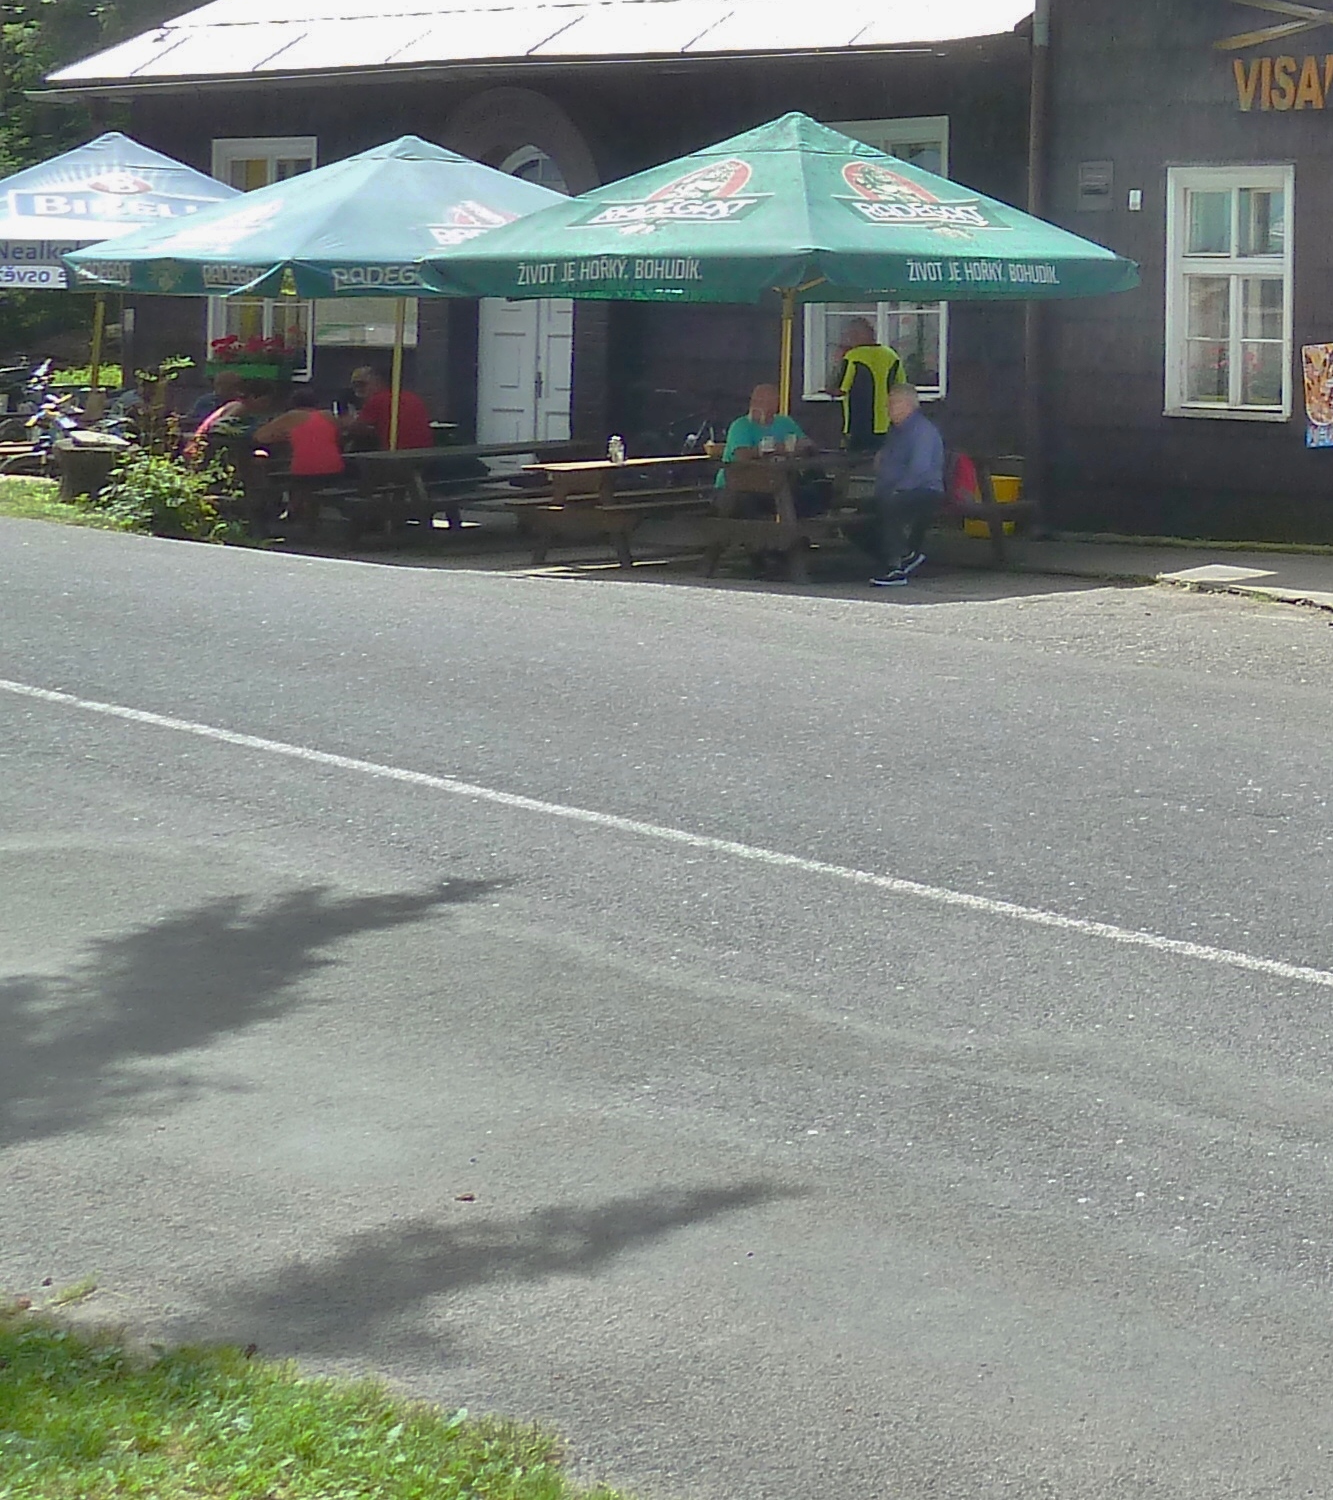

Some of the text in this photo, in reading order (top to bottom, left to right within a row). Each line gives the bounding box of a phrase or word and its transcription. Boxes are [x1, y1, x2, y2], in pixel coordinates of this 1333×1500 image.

[587, 199, 757, 225] RADEGAST
[851, 201, 989, 227] RADEGAST
[0, 240, 80, 260] Nealk
[331, 265, 421, 291] RADEG
[517, 256, 702, 286] ŽIVOT JE HOŘKÝ. BOHUDÍK.
[906, 259, 942, 282] ŽIVOT
[949, 262, 962, 282] JE
